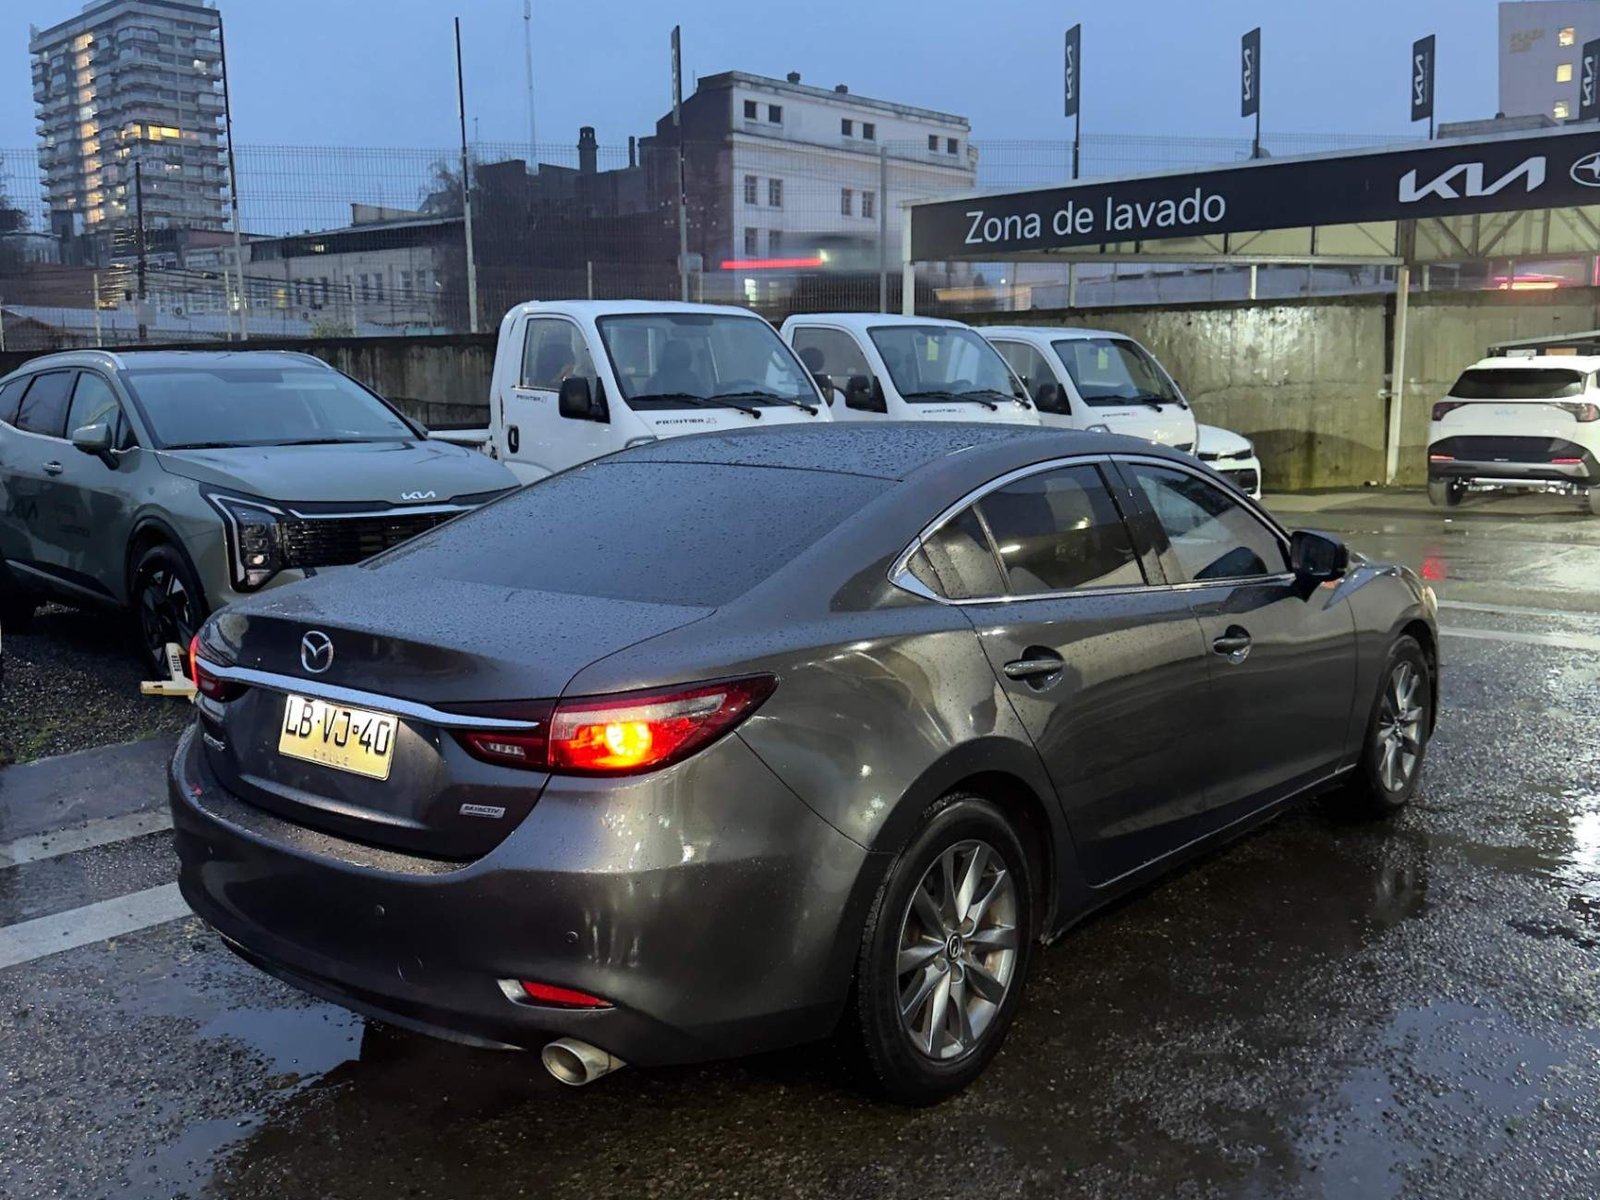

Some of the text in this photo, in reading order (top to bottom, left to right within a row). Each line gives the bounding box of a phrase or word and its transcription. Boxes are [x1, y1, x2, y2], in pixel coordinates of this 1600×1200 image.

[1243, 48, 1252, 101] KIA
[1414, 53, 1424, 106] KIA
[1582, 56, 1593, 107] KIA
[1398, 156, 1546, 203] KIA
[964, 187, 1226, 245] Zona de lavado
[401, 490, 436, 500] KIA
